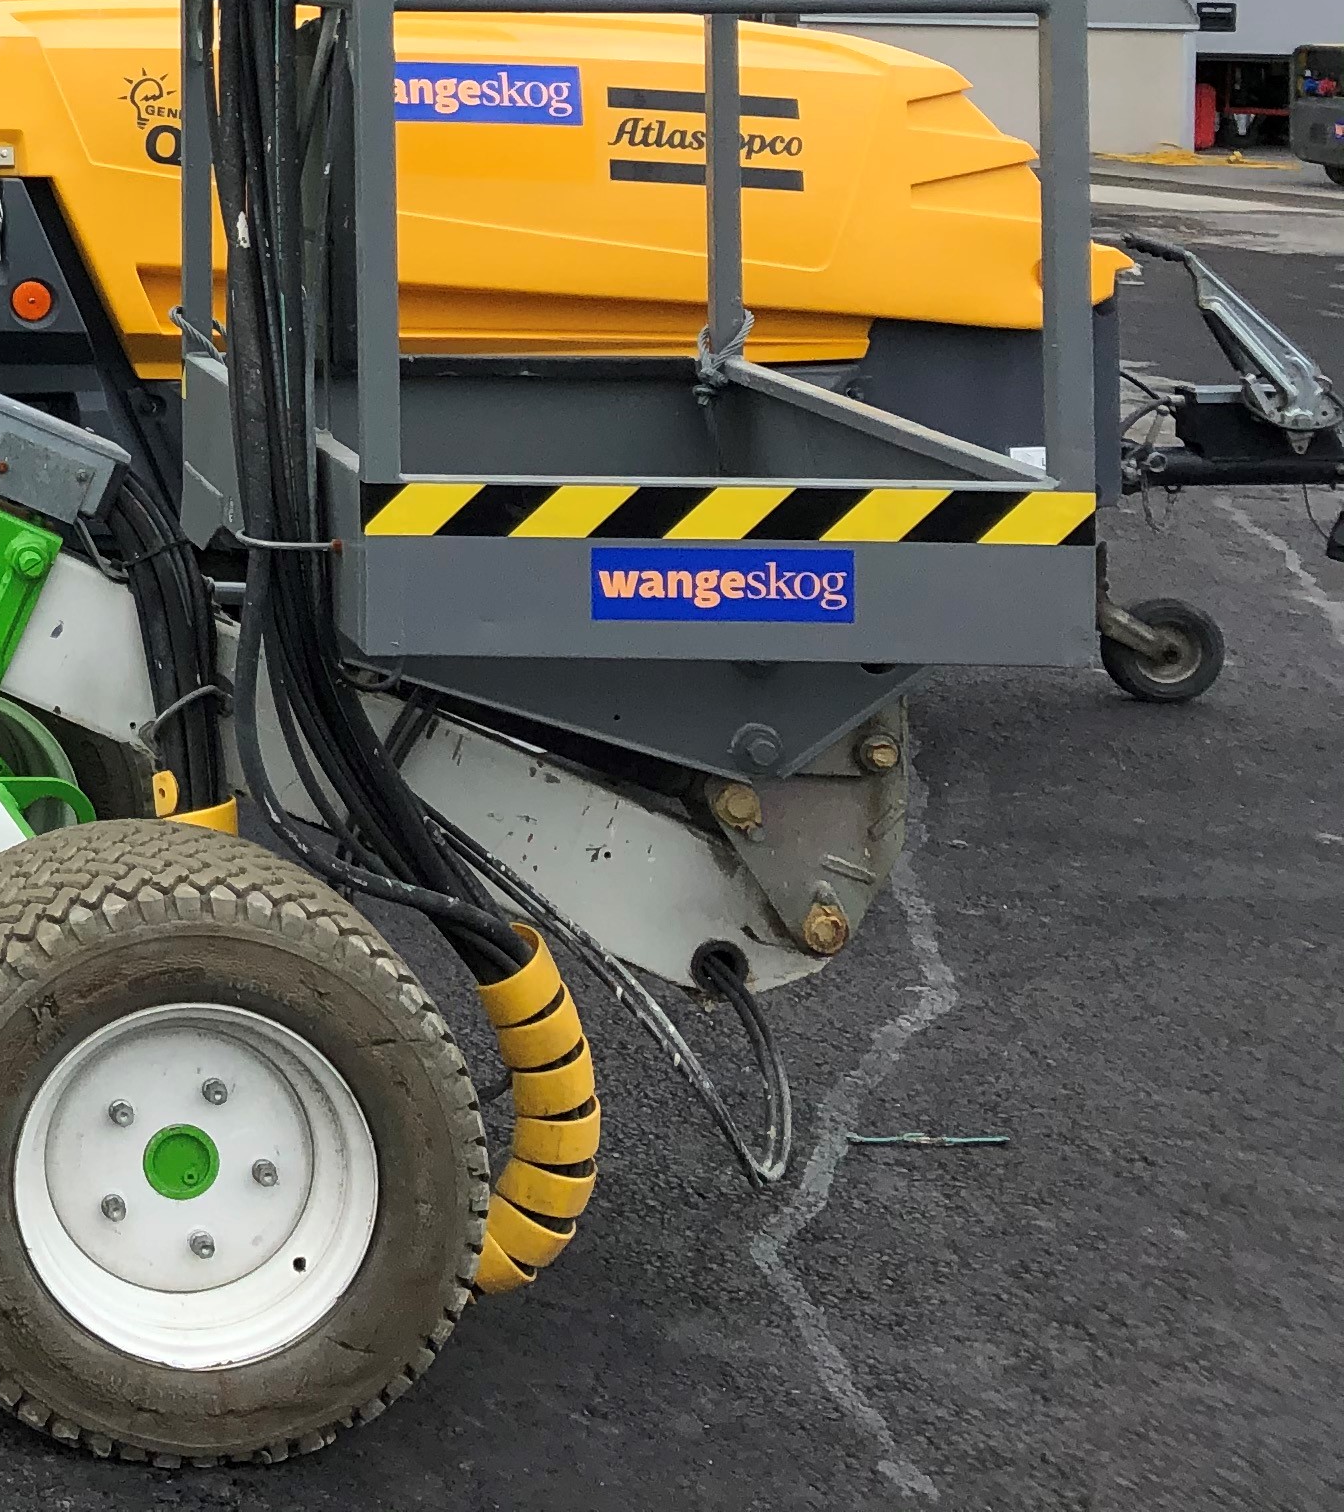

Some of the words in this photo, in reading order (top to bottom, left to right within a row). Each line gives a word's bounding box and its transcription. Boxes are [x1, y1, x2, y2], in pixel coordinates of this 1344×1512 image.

[394, 71, 574, 118] angeskog
[607, 117, 705, 150] Atlas
[598, 561, 849, 611] wangeskog
